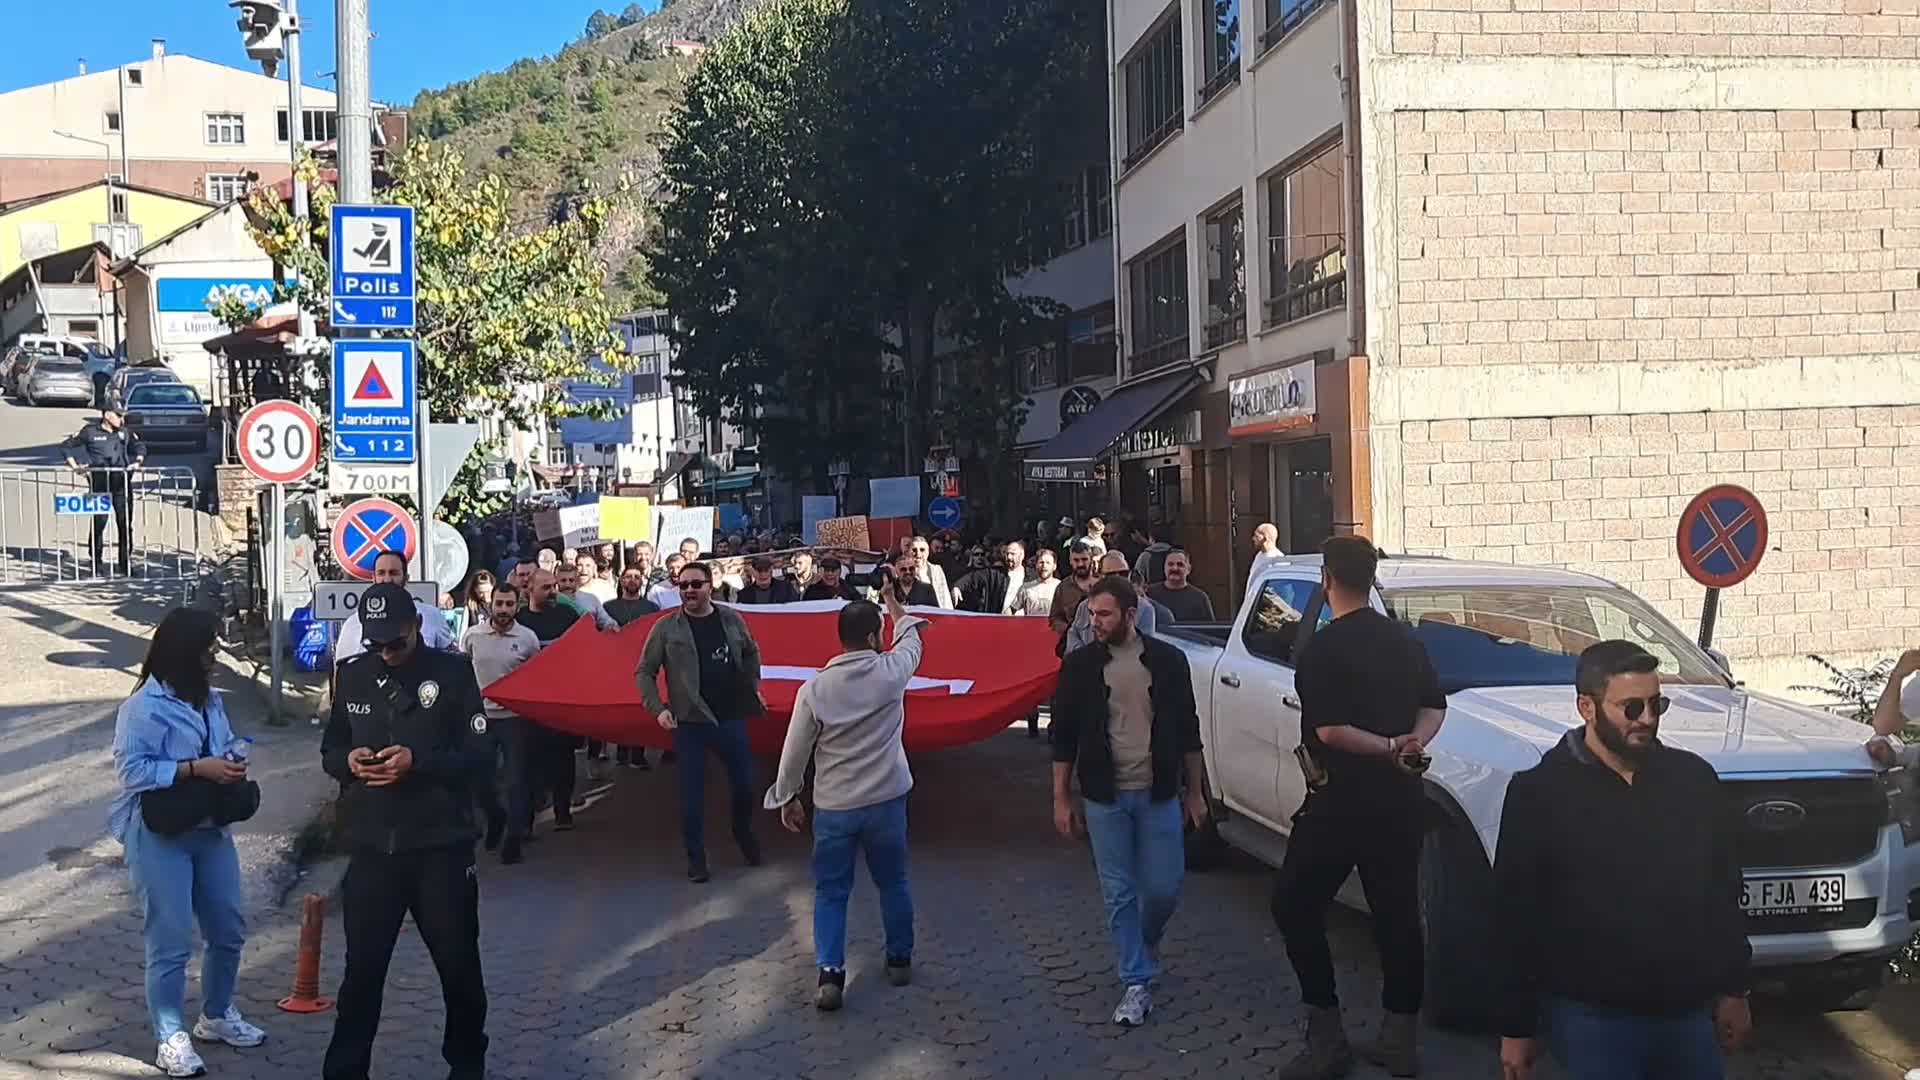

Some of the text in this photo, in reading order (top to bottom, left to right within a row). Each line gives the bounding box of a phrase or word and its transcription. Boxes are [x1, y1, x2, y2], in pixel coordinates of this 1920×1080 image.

[345, 277, 400, 294] Polis
[381, 305, 397, 318] 112
[337, 413, 410, 425] Jandarma
[255, 423, 304, 460] 30
[368, 439, 405, 452] 112
[1762, 882, 1795, 905] FJA
[1809, 880, 1841, 903] 439
